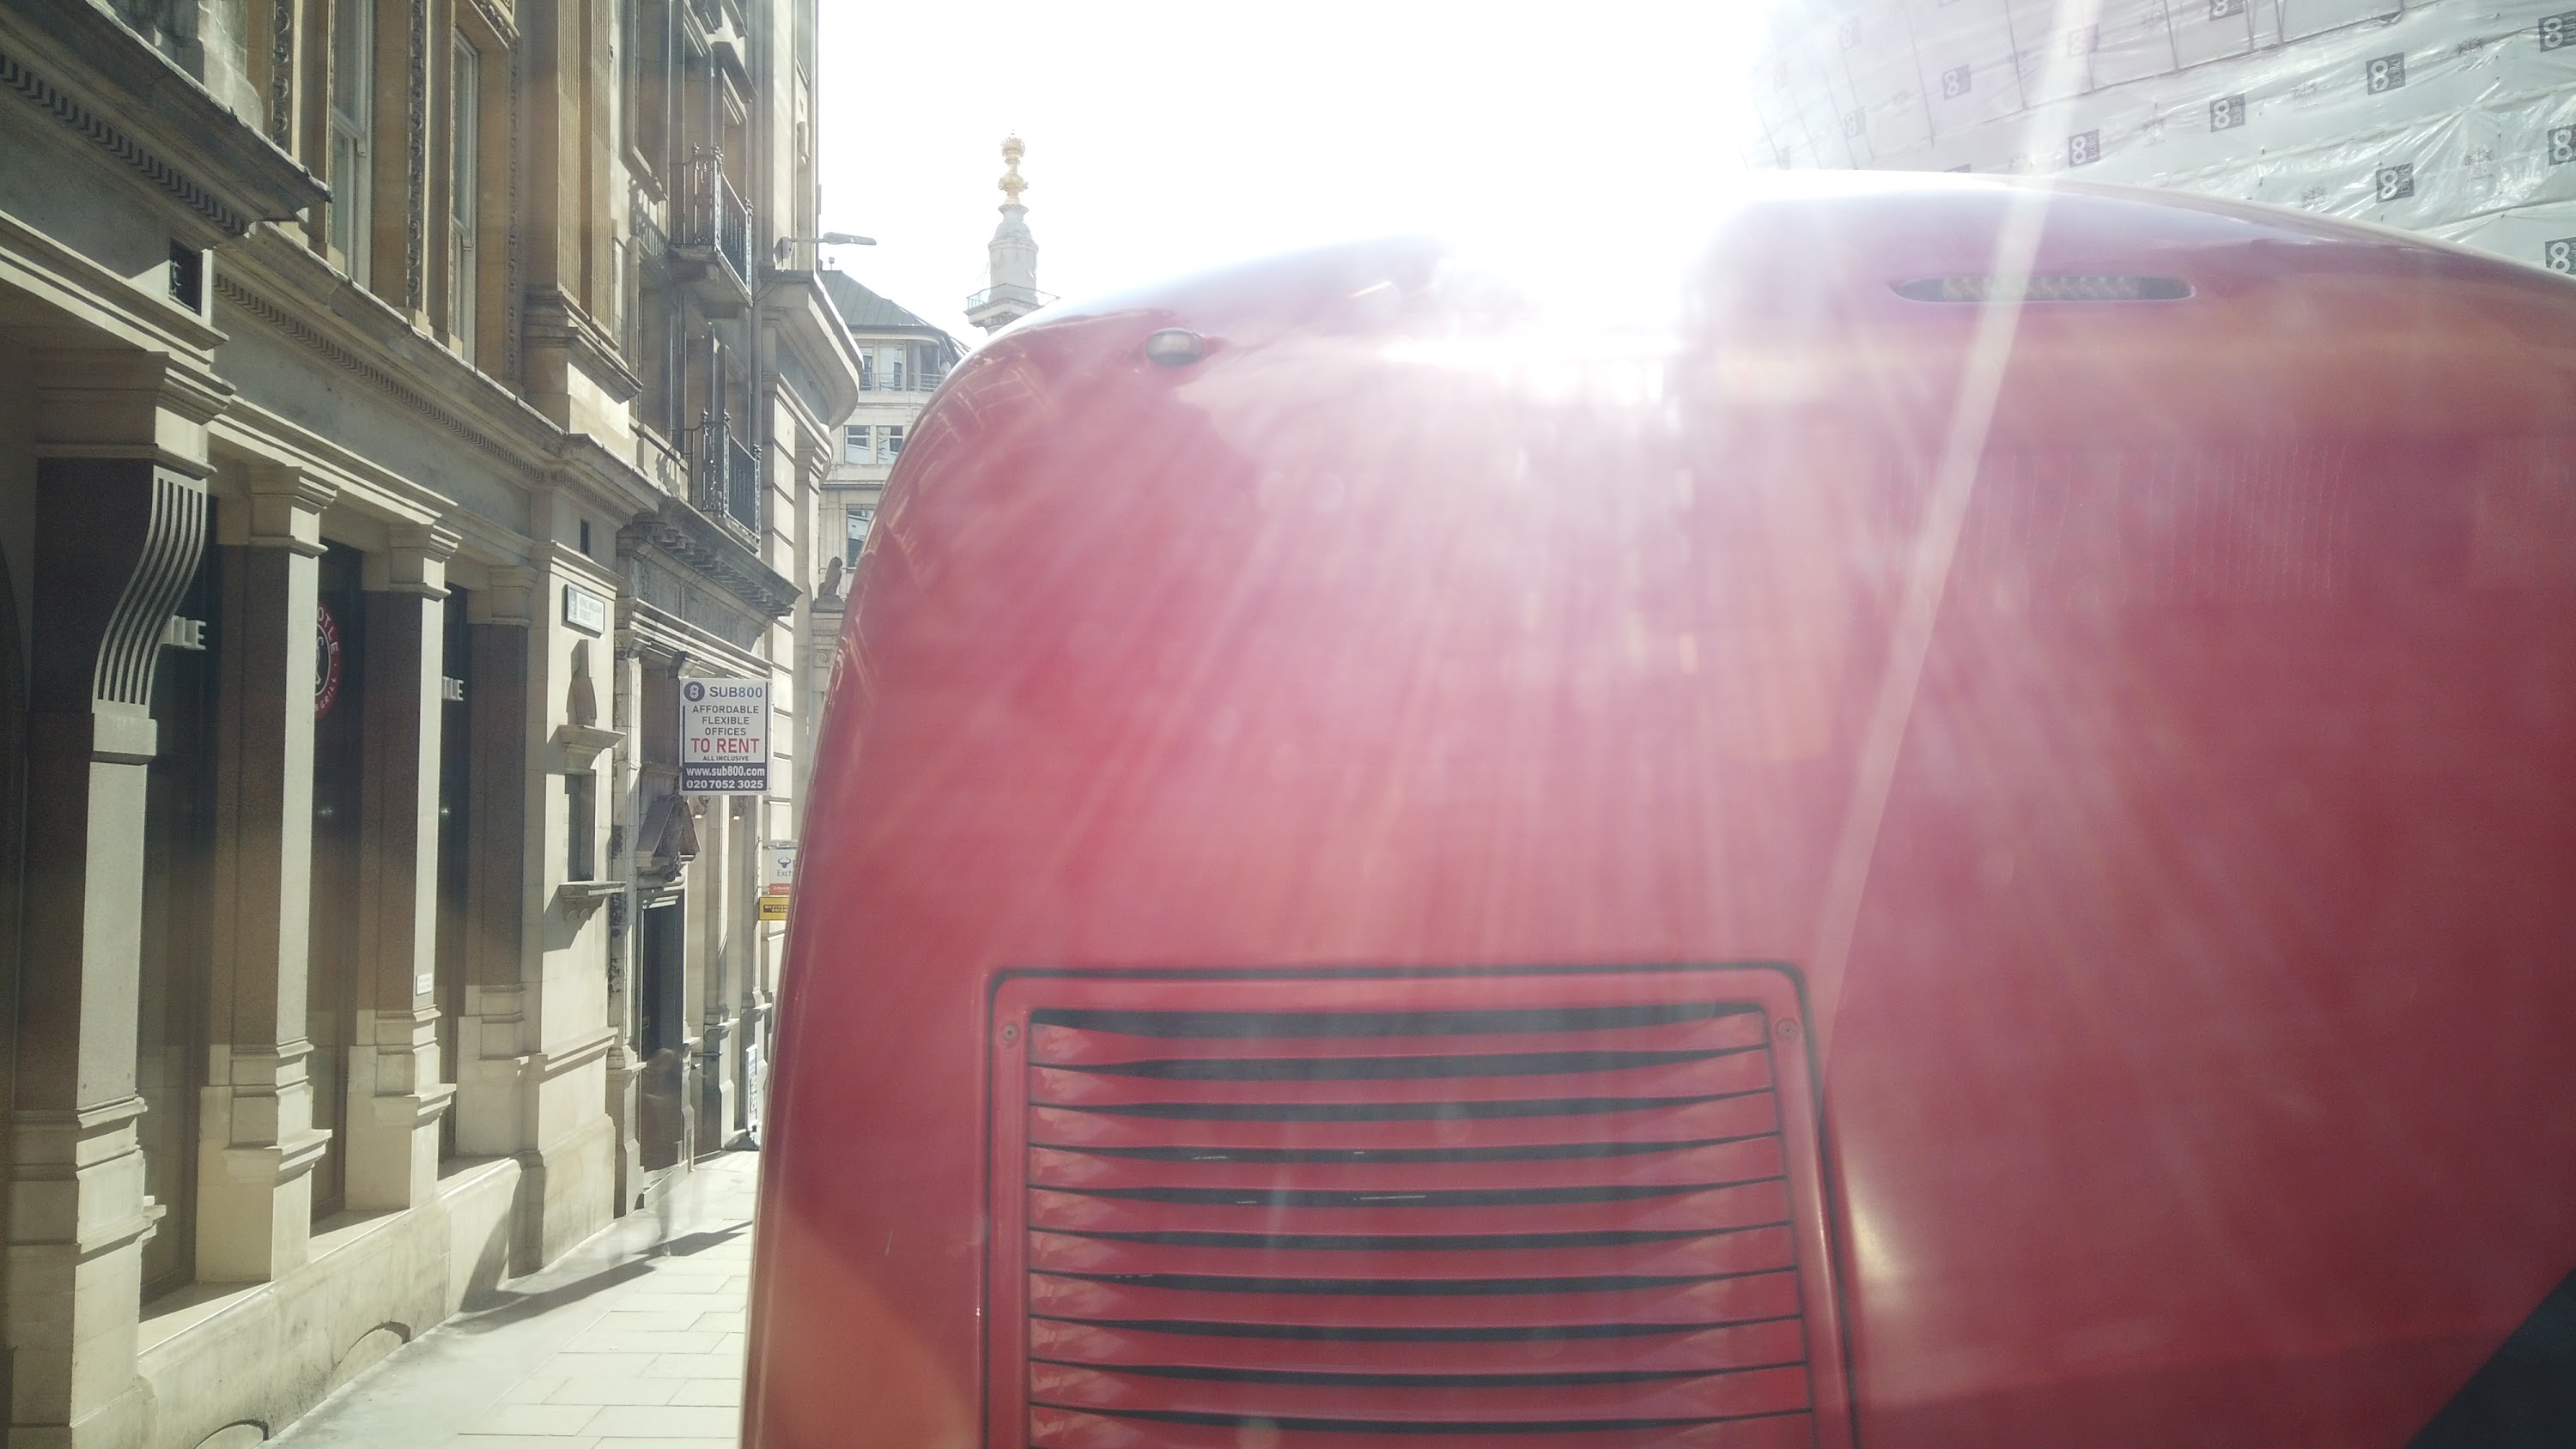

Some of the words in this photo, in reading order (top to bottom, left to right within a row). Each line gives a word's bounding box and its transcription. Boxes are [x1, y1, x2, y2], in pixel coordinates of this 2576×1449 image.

[2543, 17, 2563, 48] 8
[1943, 70, 1959, 96] 8
[2371, 60, 2389, 91] 8
[2214, 100, 2231, 129] 8
[2072, 136, 2087, 164] 8
[2553, 130, 2573, 161] 8
[2380, 170, 2398, 199] 8
[2550, 242, 2571, 274] 8
[709, 686, 762, 698] SUB800
[692, 705, 759, 714] AFFORDABLE
[702, 716, 750, 725] FLEXIBLE
[704, 727, 746, 736] OFFICES
[690, 738, 711, 753] TO
[717, 738, 760, 753] RENT
[686, 766, 765, 776] www.sub800.com
[686, 779, 708, 789] 020
[709, 779, 736, 789] 7052
[738, 779, 763, 789] 3025
